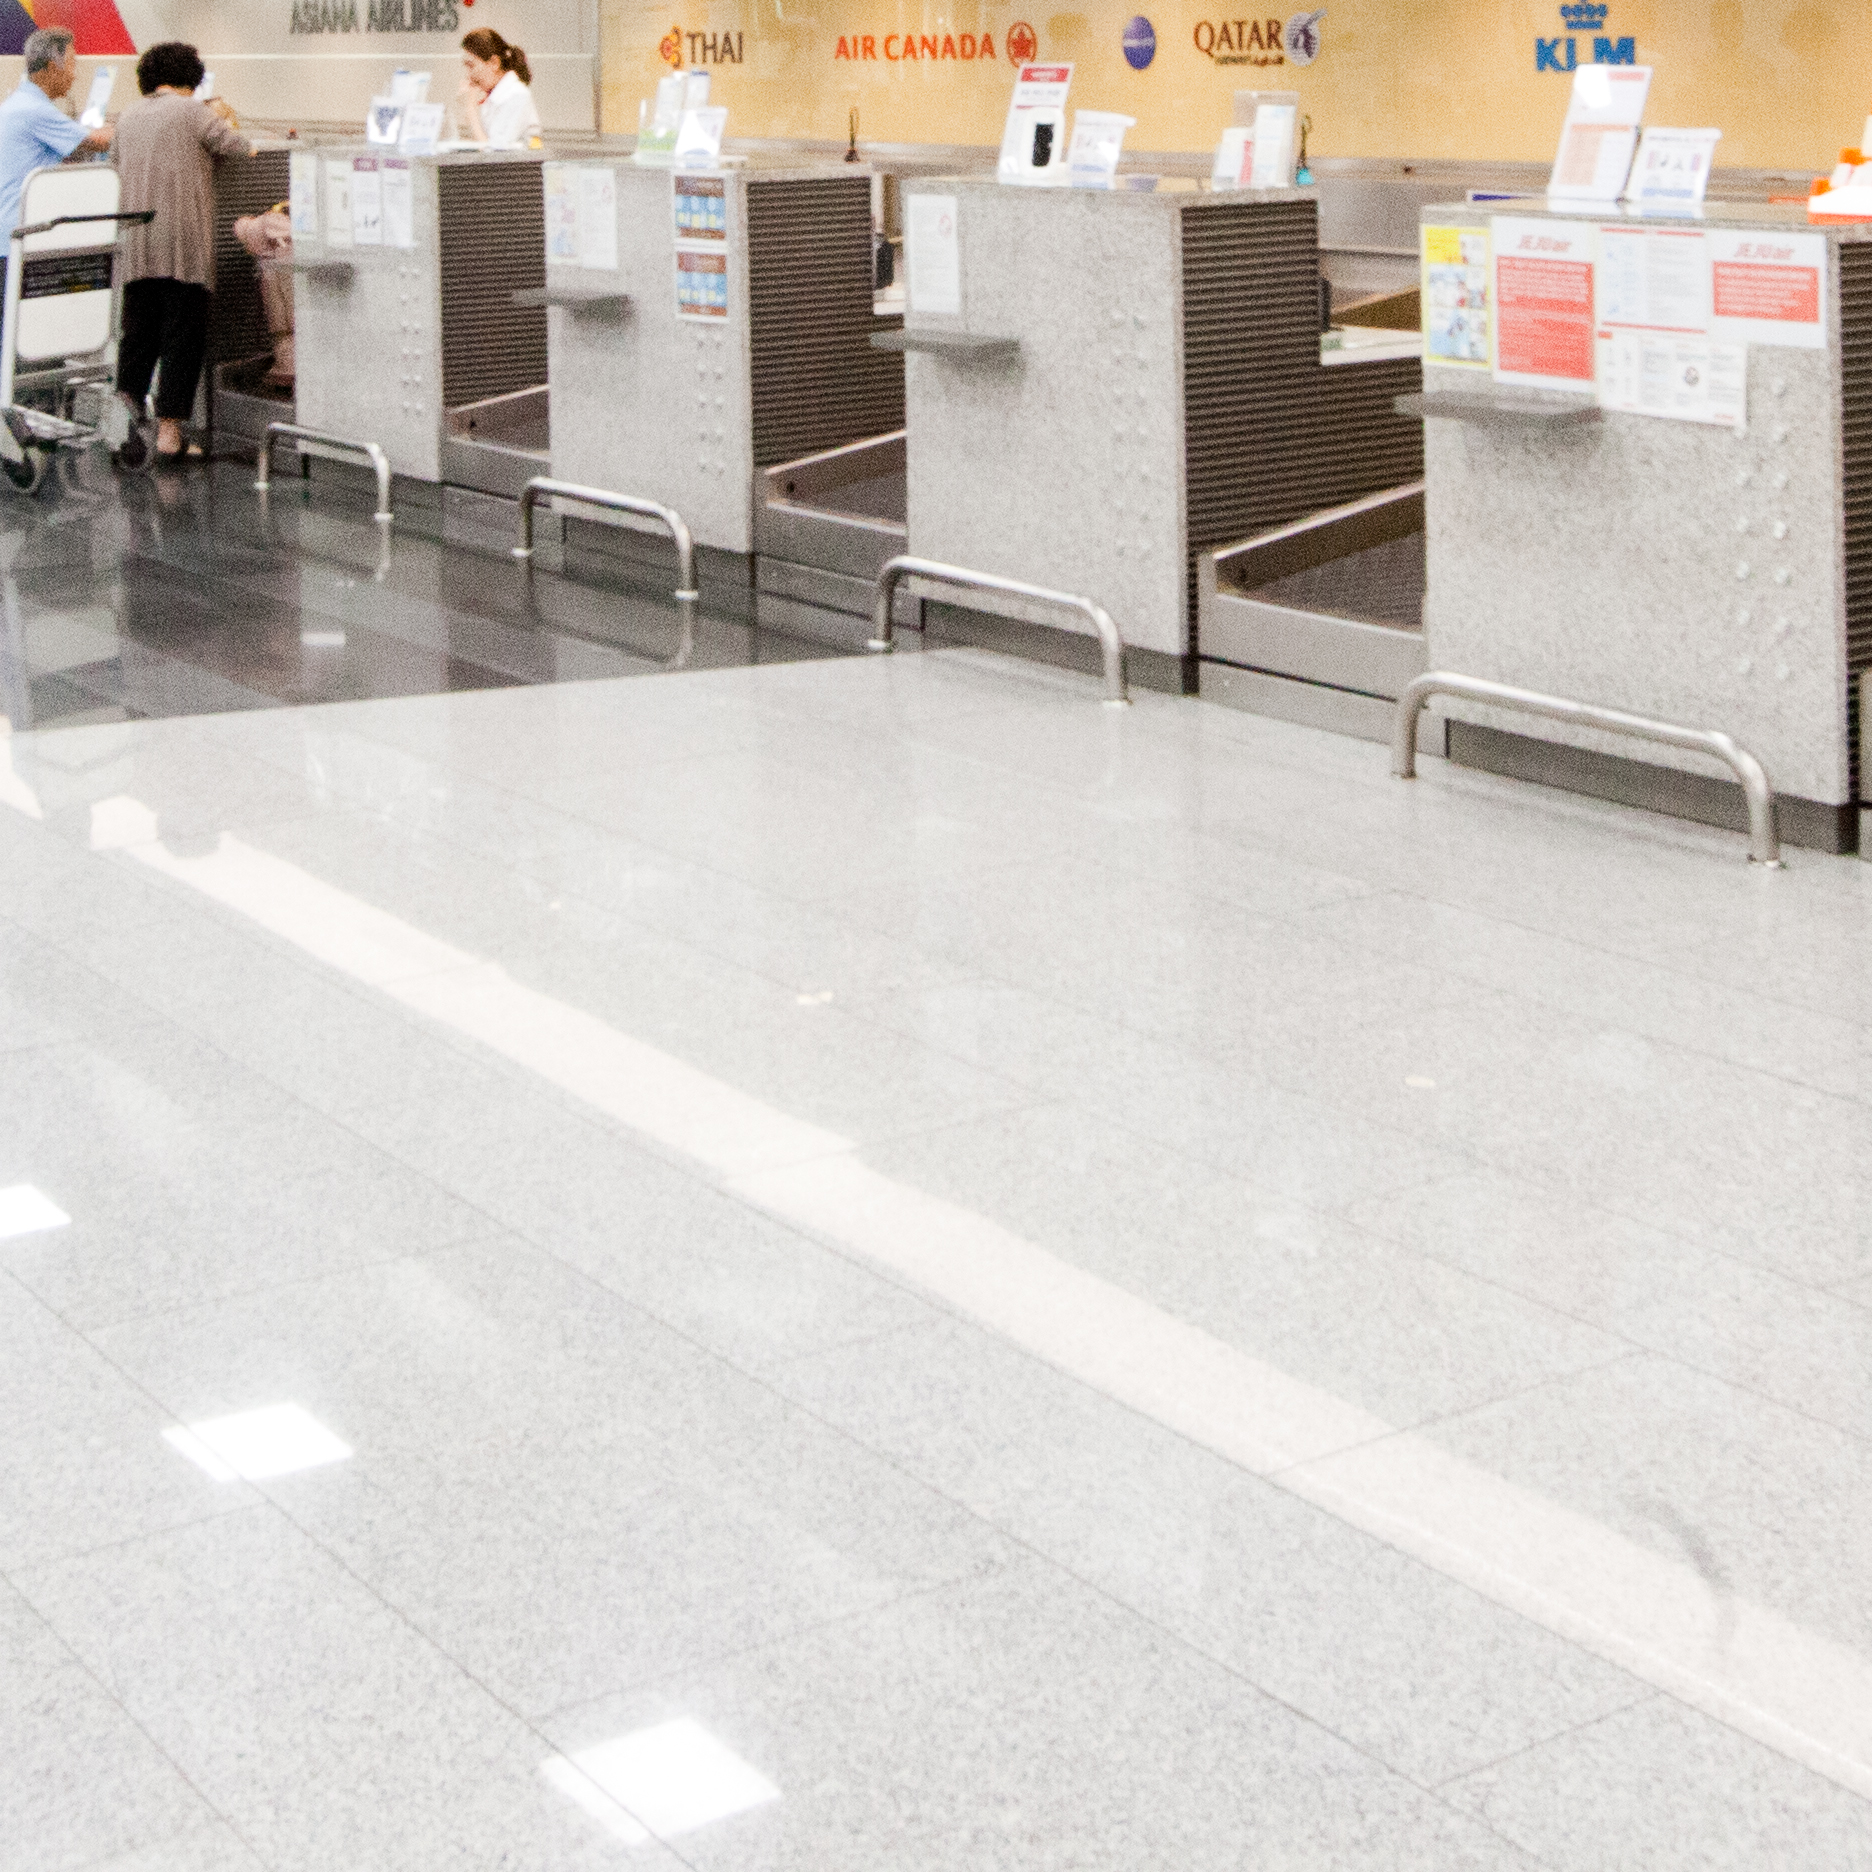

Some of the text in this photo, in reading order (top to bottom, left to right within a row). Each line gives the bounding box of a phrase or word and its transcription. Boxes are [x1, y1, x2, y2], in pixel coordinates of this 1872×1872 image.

[686, 30, 744, 64] THAI
[835, 32, 997, 61] AIR CANADA
[1193, 18, 1283, 58] QATAR
